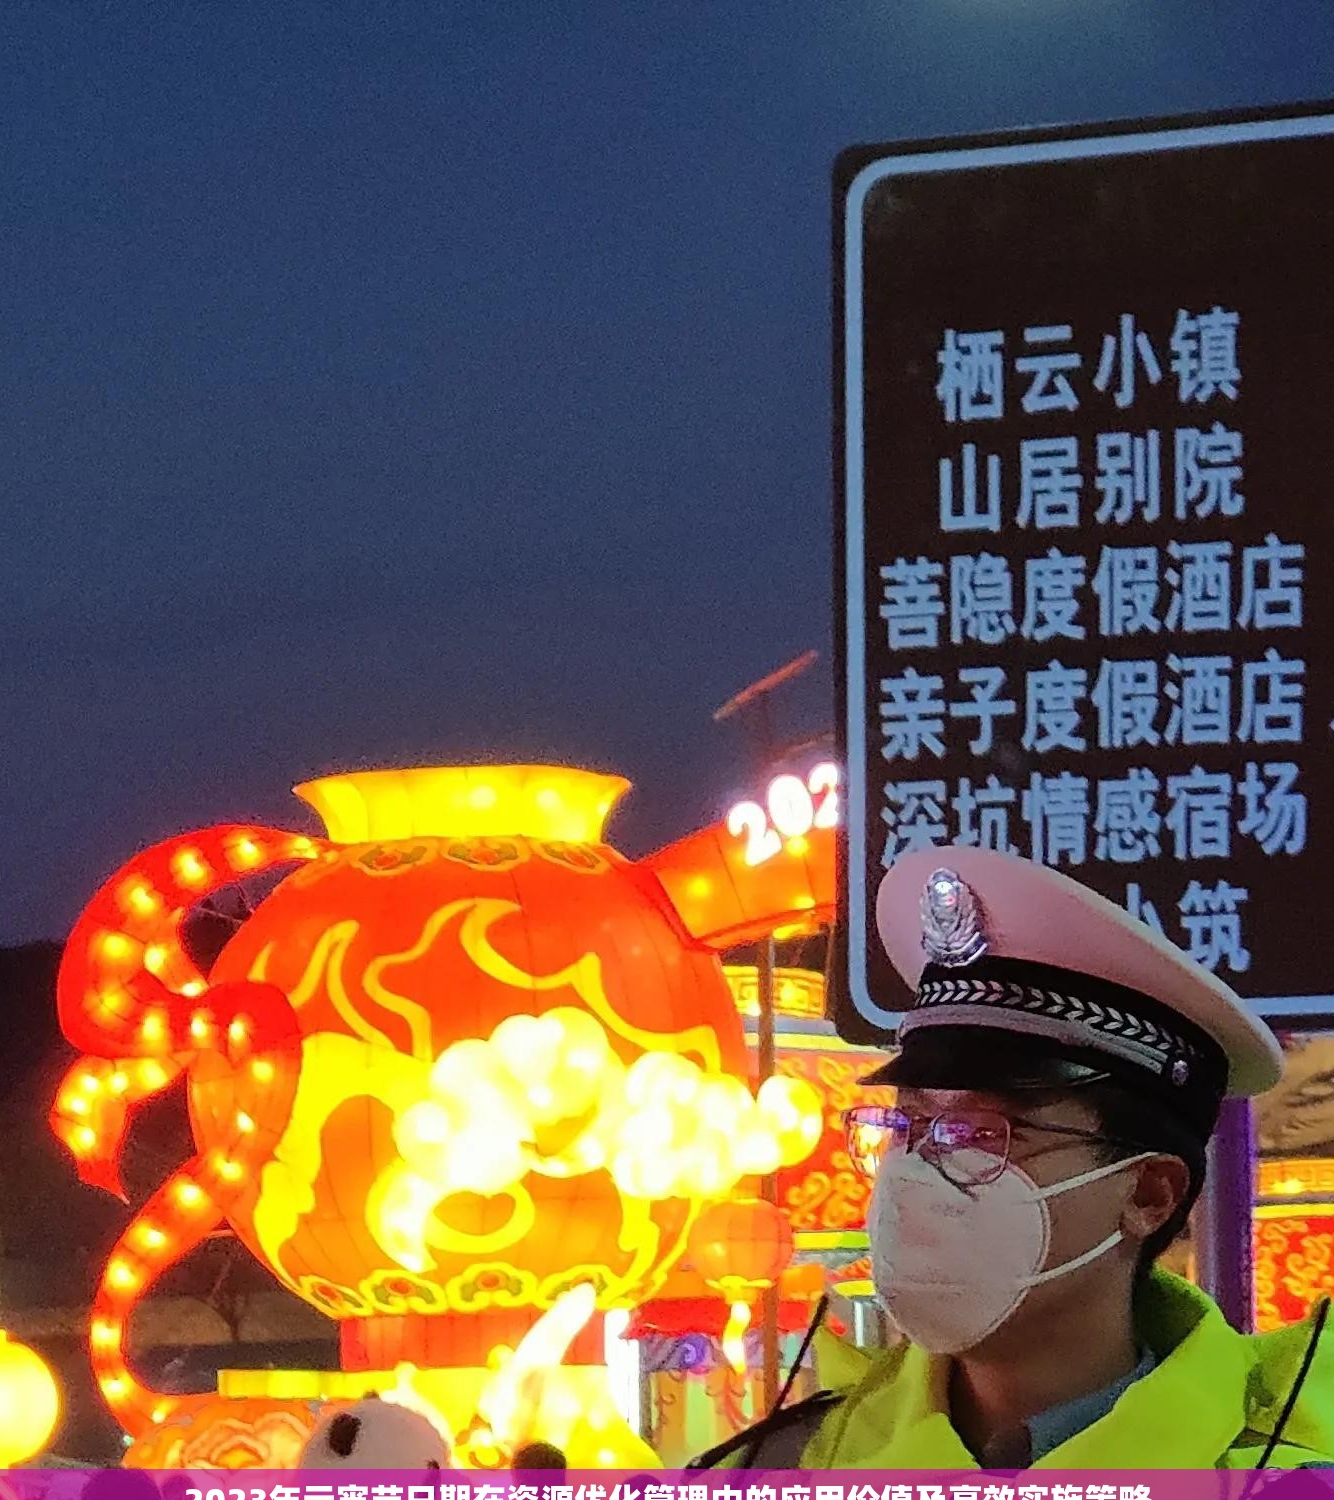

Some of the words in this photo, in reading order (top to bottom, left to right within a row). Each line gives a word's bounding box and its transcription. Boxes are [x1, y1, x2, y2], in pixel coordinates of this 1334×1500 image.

[936, 306, 1242, 422] 栖云小镇
[938, 421, 1245, 533] 山居别院
[879, 532, 1306, 651] 菩隐度假酒店
[879, 649, 1306, 762] 亲子度假酒店
[879, 761, 1309, 869] 深坑情感宿场
